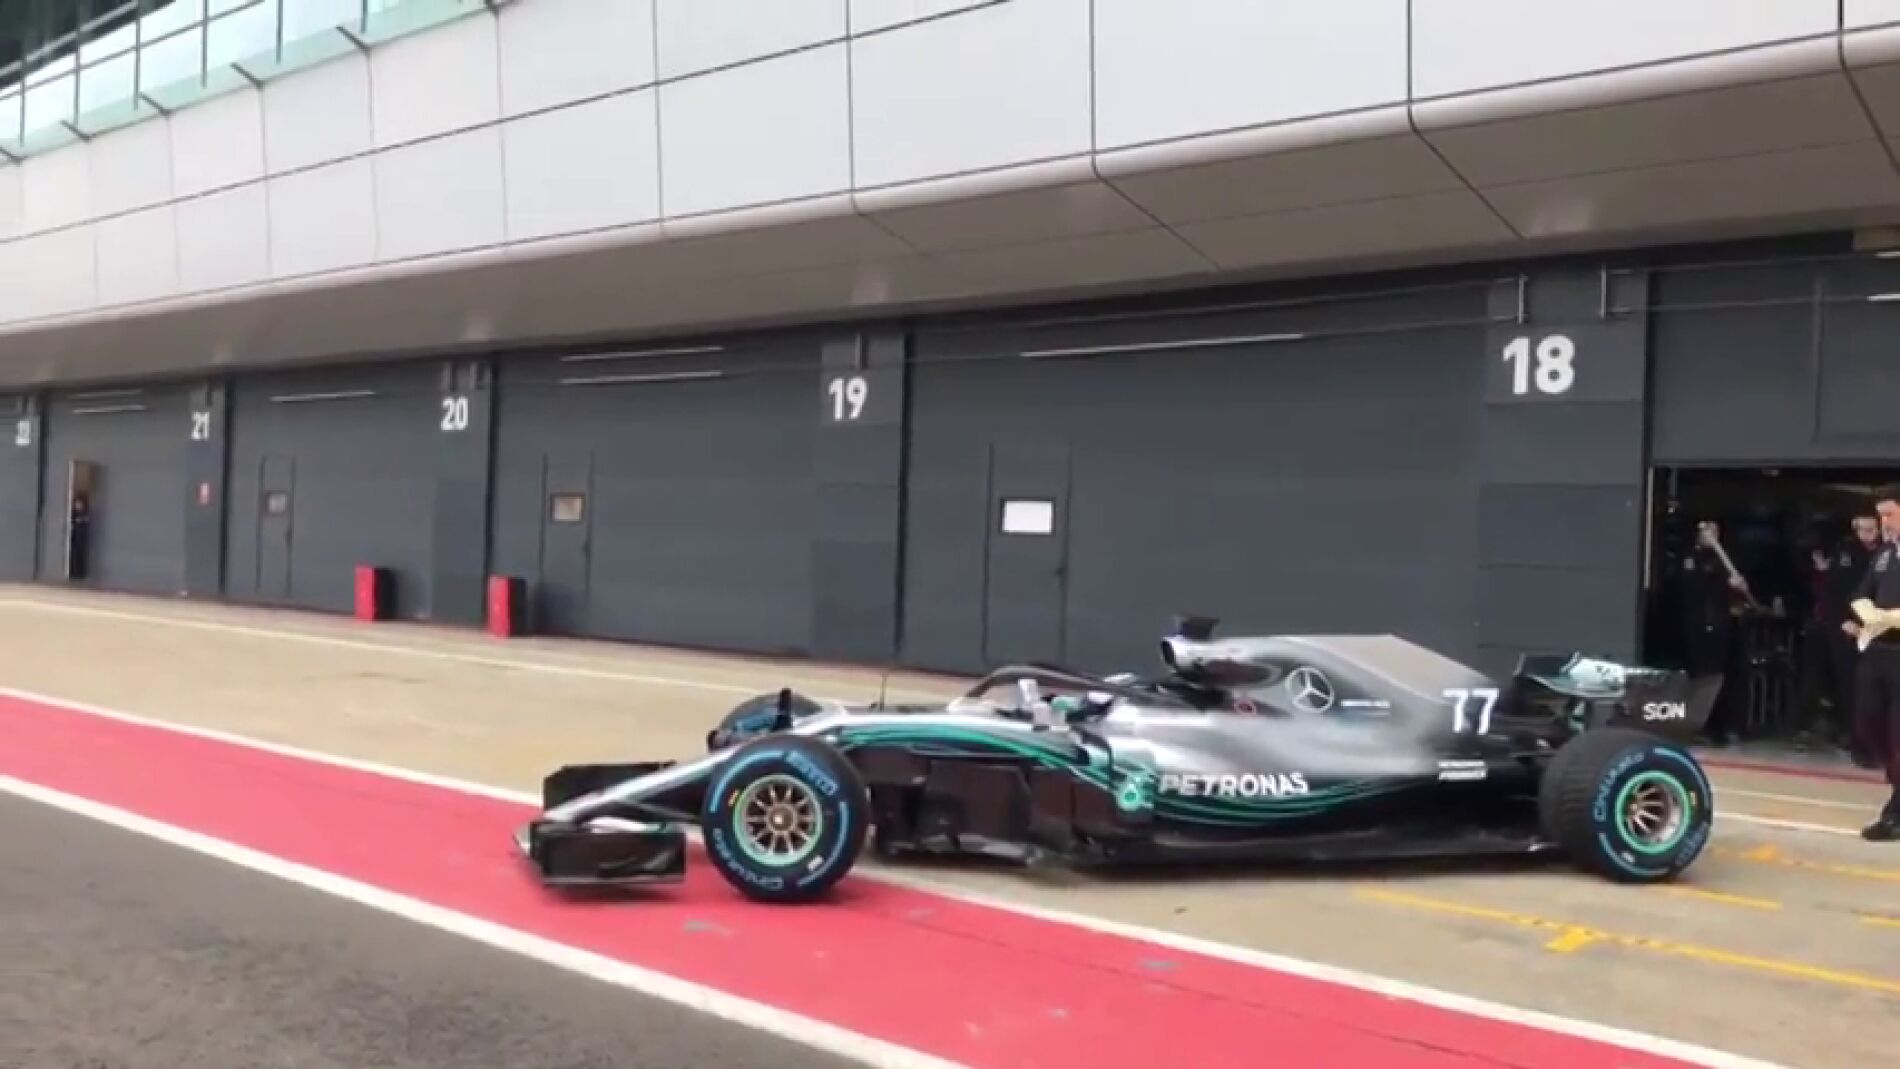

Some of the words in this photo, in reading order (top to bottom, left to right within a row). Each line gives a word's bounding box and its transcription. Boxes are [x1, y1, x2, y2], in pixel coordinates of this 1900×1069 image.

[1503, 334, 1575, 394] 18
[441, 396, 469, 432] 20
[828, 376, 868, 420] 19
[191, 411, 210, 441] 21
[1442, 688, 1500, 735] 77
[1643, 702, 1686, 721] SON
[1159, 771, 1310, 797] PETRONAS
